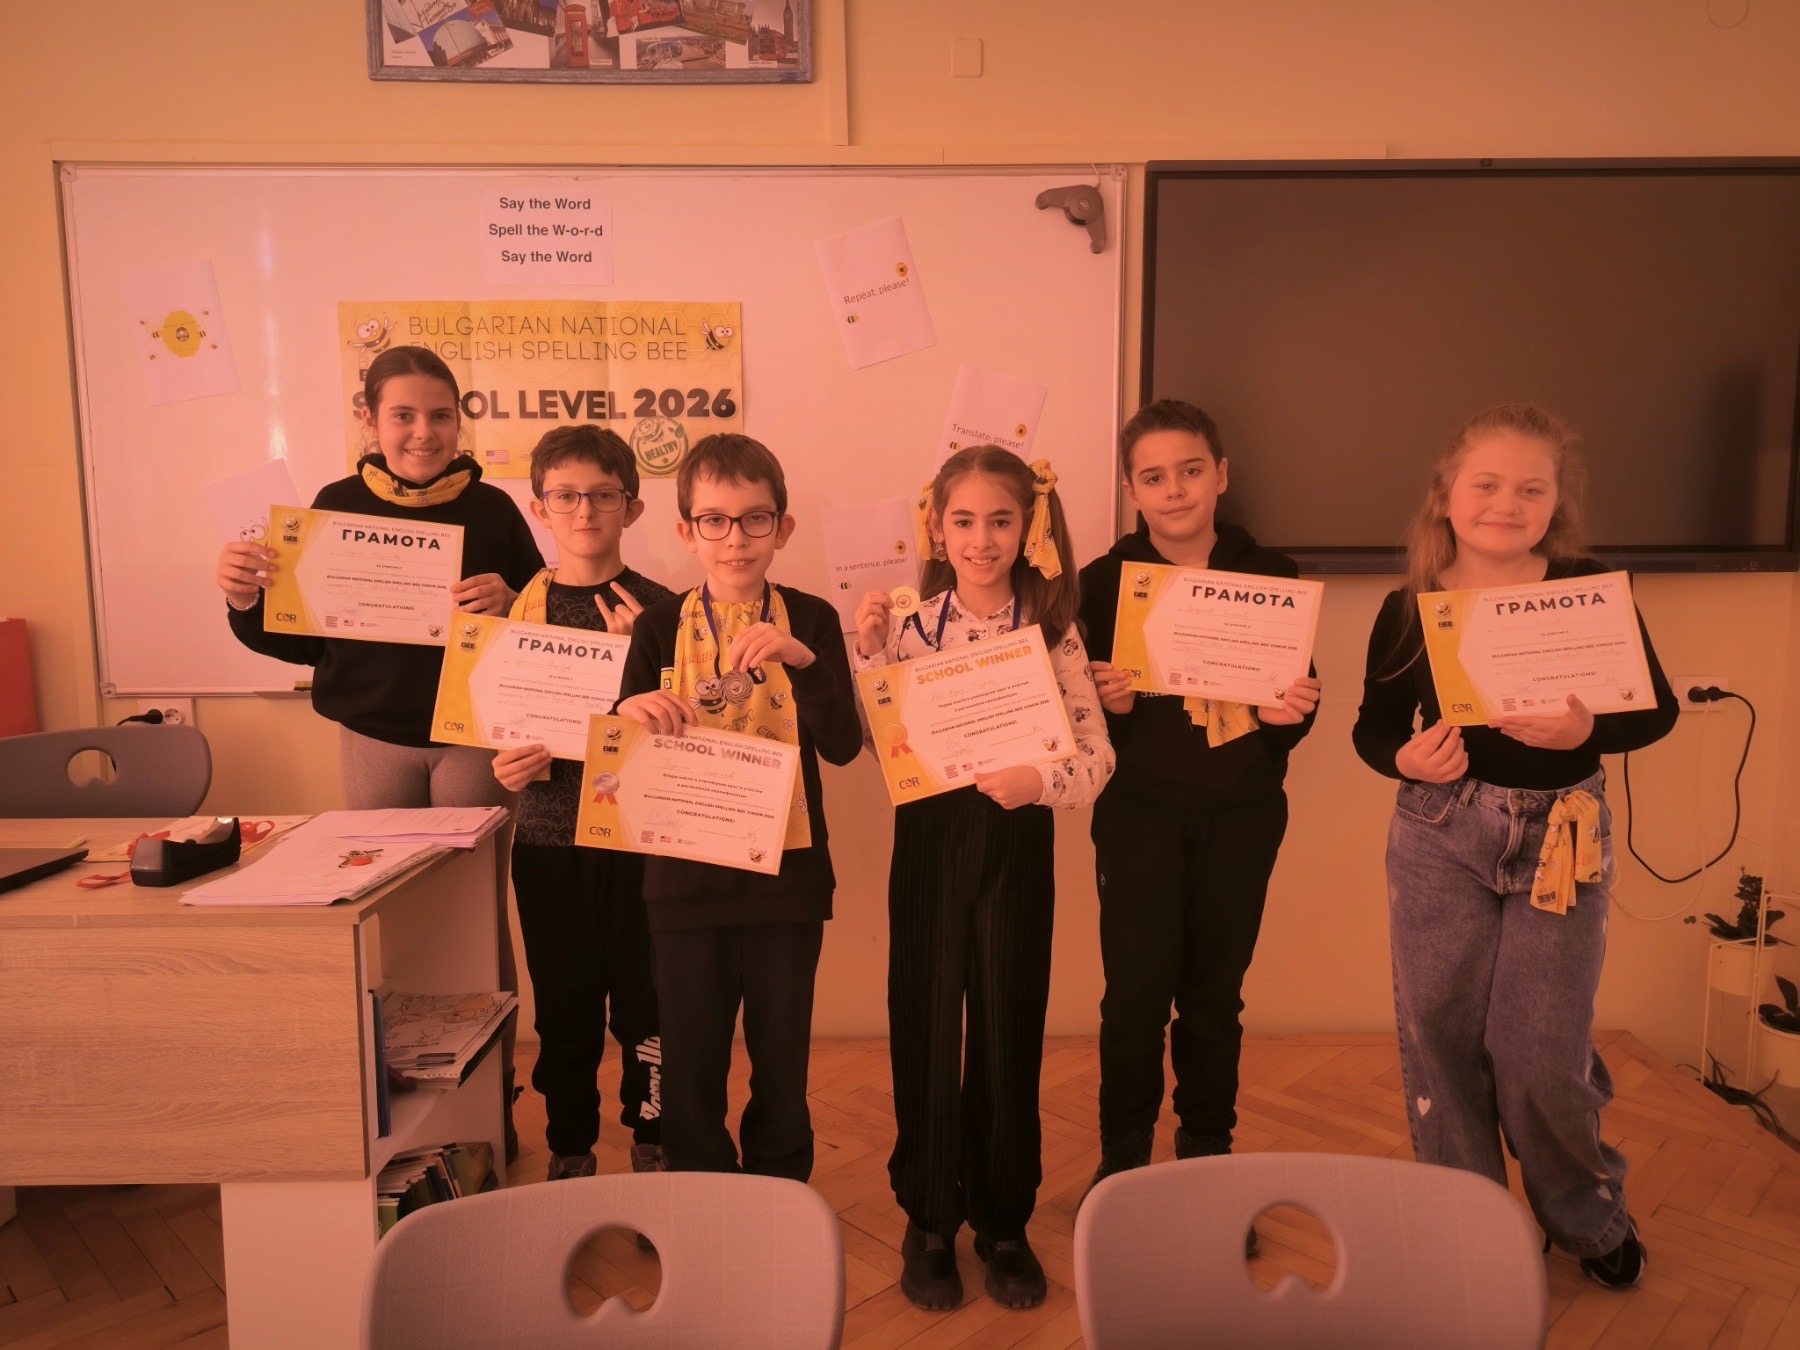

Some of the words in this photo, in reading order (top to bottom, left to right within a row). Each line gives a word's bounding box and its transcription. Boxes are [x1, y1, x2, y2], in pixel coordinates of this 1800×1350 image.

[499, 197, 525, 212] Say
[529, 198, 551, 210] the
[554, 198, 591, 210] Word
[489, 223, 523, 238] Spell
[527, 224, 549, 236] the
[552, 224, 603, 237] W-o-r-d
[501, 250, 527, 265] Say
[530, 250, 552, 262] the
[556, 250, 593, 263] Word
[878, 276, 910, 296] please!
[409, 315, 550, 335] BULGARIAN
[562, 316, 686, 336] NATIONAL
[522, 340, 637, 361] SPELLING
[647, 341, 687, 360] BEE
[518, 389, 627, 421] LEVEL
[633, 388, 737, 418] 2026
[644, 439, 680, 461] HEALTHY
[341, 528, 441, 550] ГРАМОТА
[358, 601, 415, 610] CONGRATULATIONS!
[1191, 585, 1296, 608] ГРАМОТА
[1494, 591, 1606, 615] ГРАМОТА
[517, 637, 614, 661] ГРАМОТА
[915, 660, 973, 685] SCHOOL
[974, 644, 1033, 669] WINNER
[1202, 659, 1261, 671] CONGRATULATIONS!
[1532, 671, 1597, 682] CONGRATULATIONS!
[525, 712, 582, 724] CONGRATULATIONS!
[963, 719, 1017, 739] CONGRATULATIONS!
[653, 737, 716, 758] SCHOOL
[719, 748, 782, 769] WINNER
[676, 809, 735, 824] CONGRATULATIONS!
